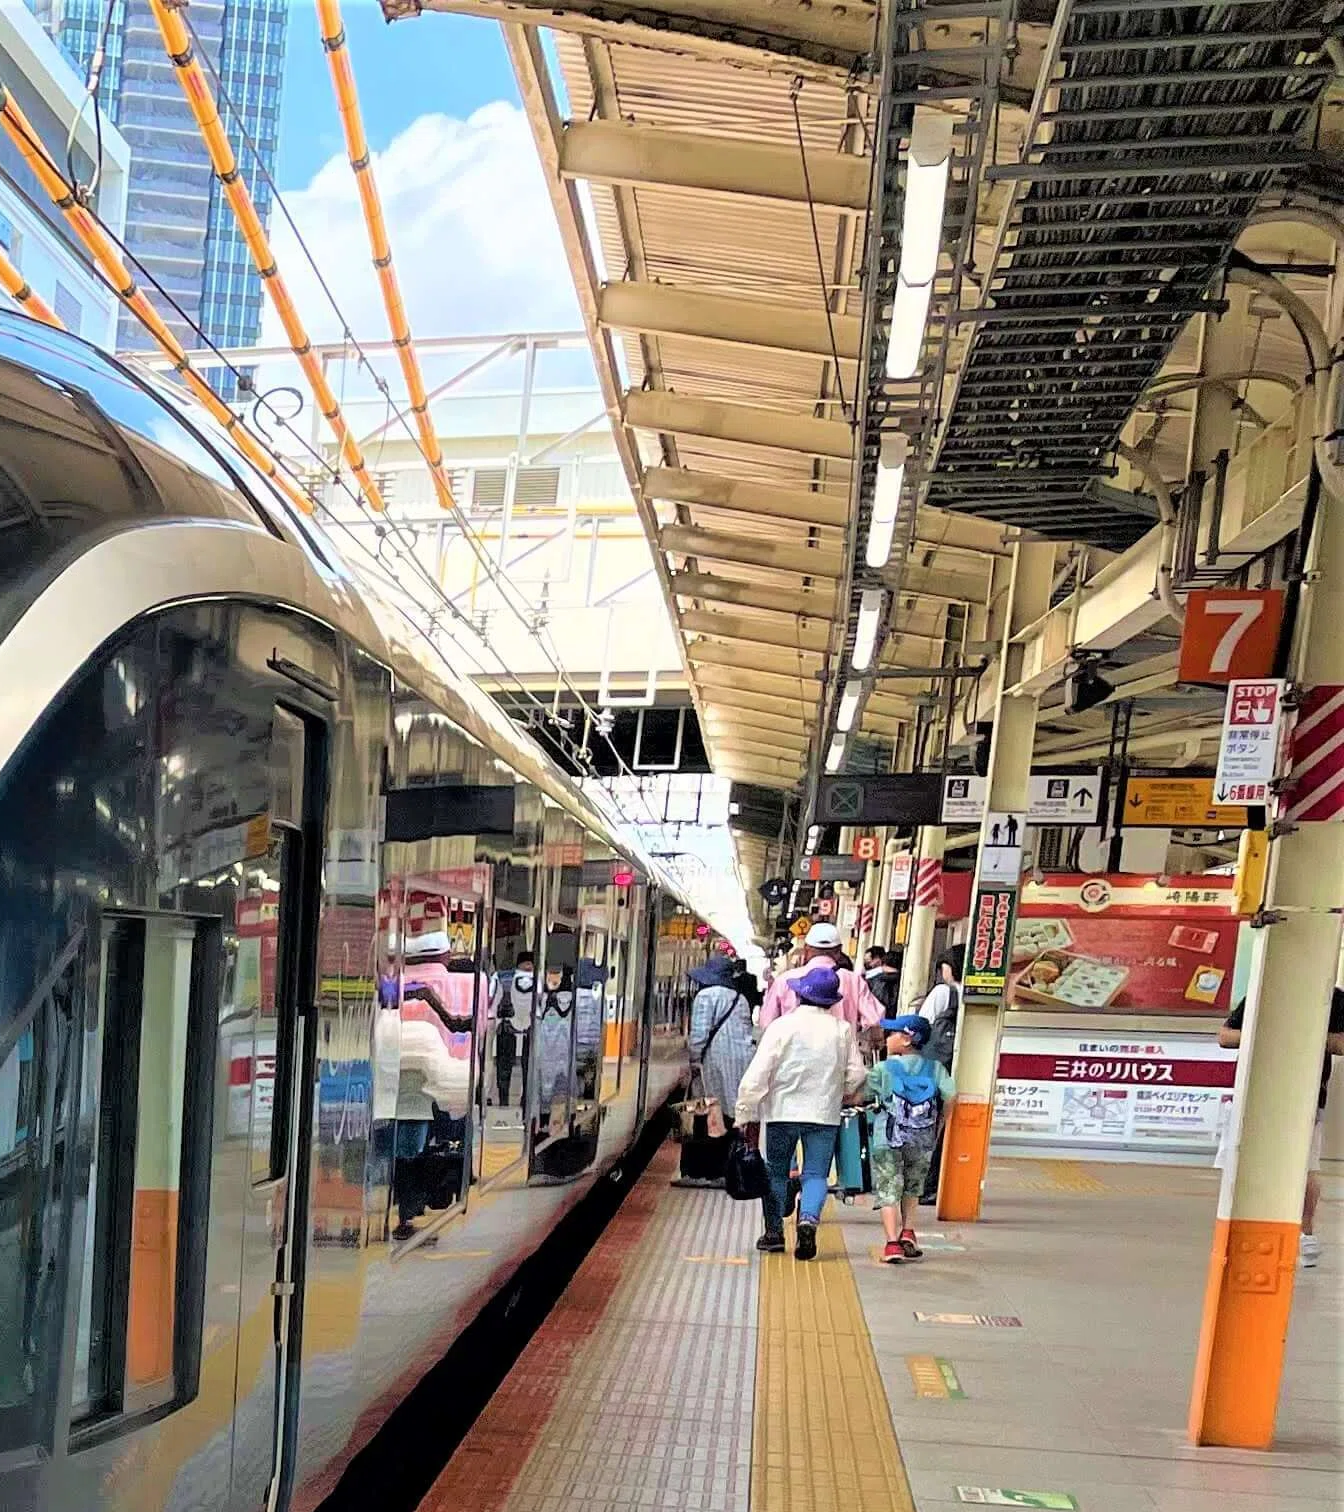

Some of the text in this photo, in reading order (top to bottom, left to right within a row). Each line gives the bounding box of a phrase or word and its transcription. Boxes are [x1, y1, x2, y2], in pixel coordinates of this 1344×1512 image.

[1203, 599, 1265, 674] 7
[1235, 685, 1277, 699] STOP
[1225, 741, 1260, 754] ボタン
[857, 837, 875, 859] 8
[1052, 1059, 1175, 1081] 三井のリハウス
